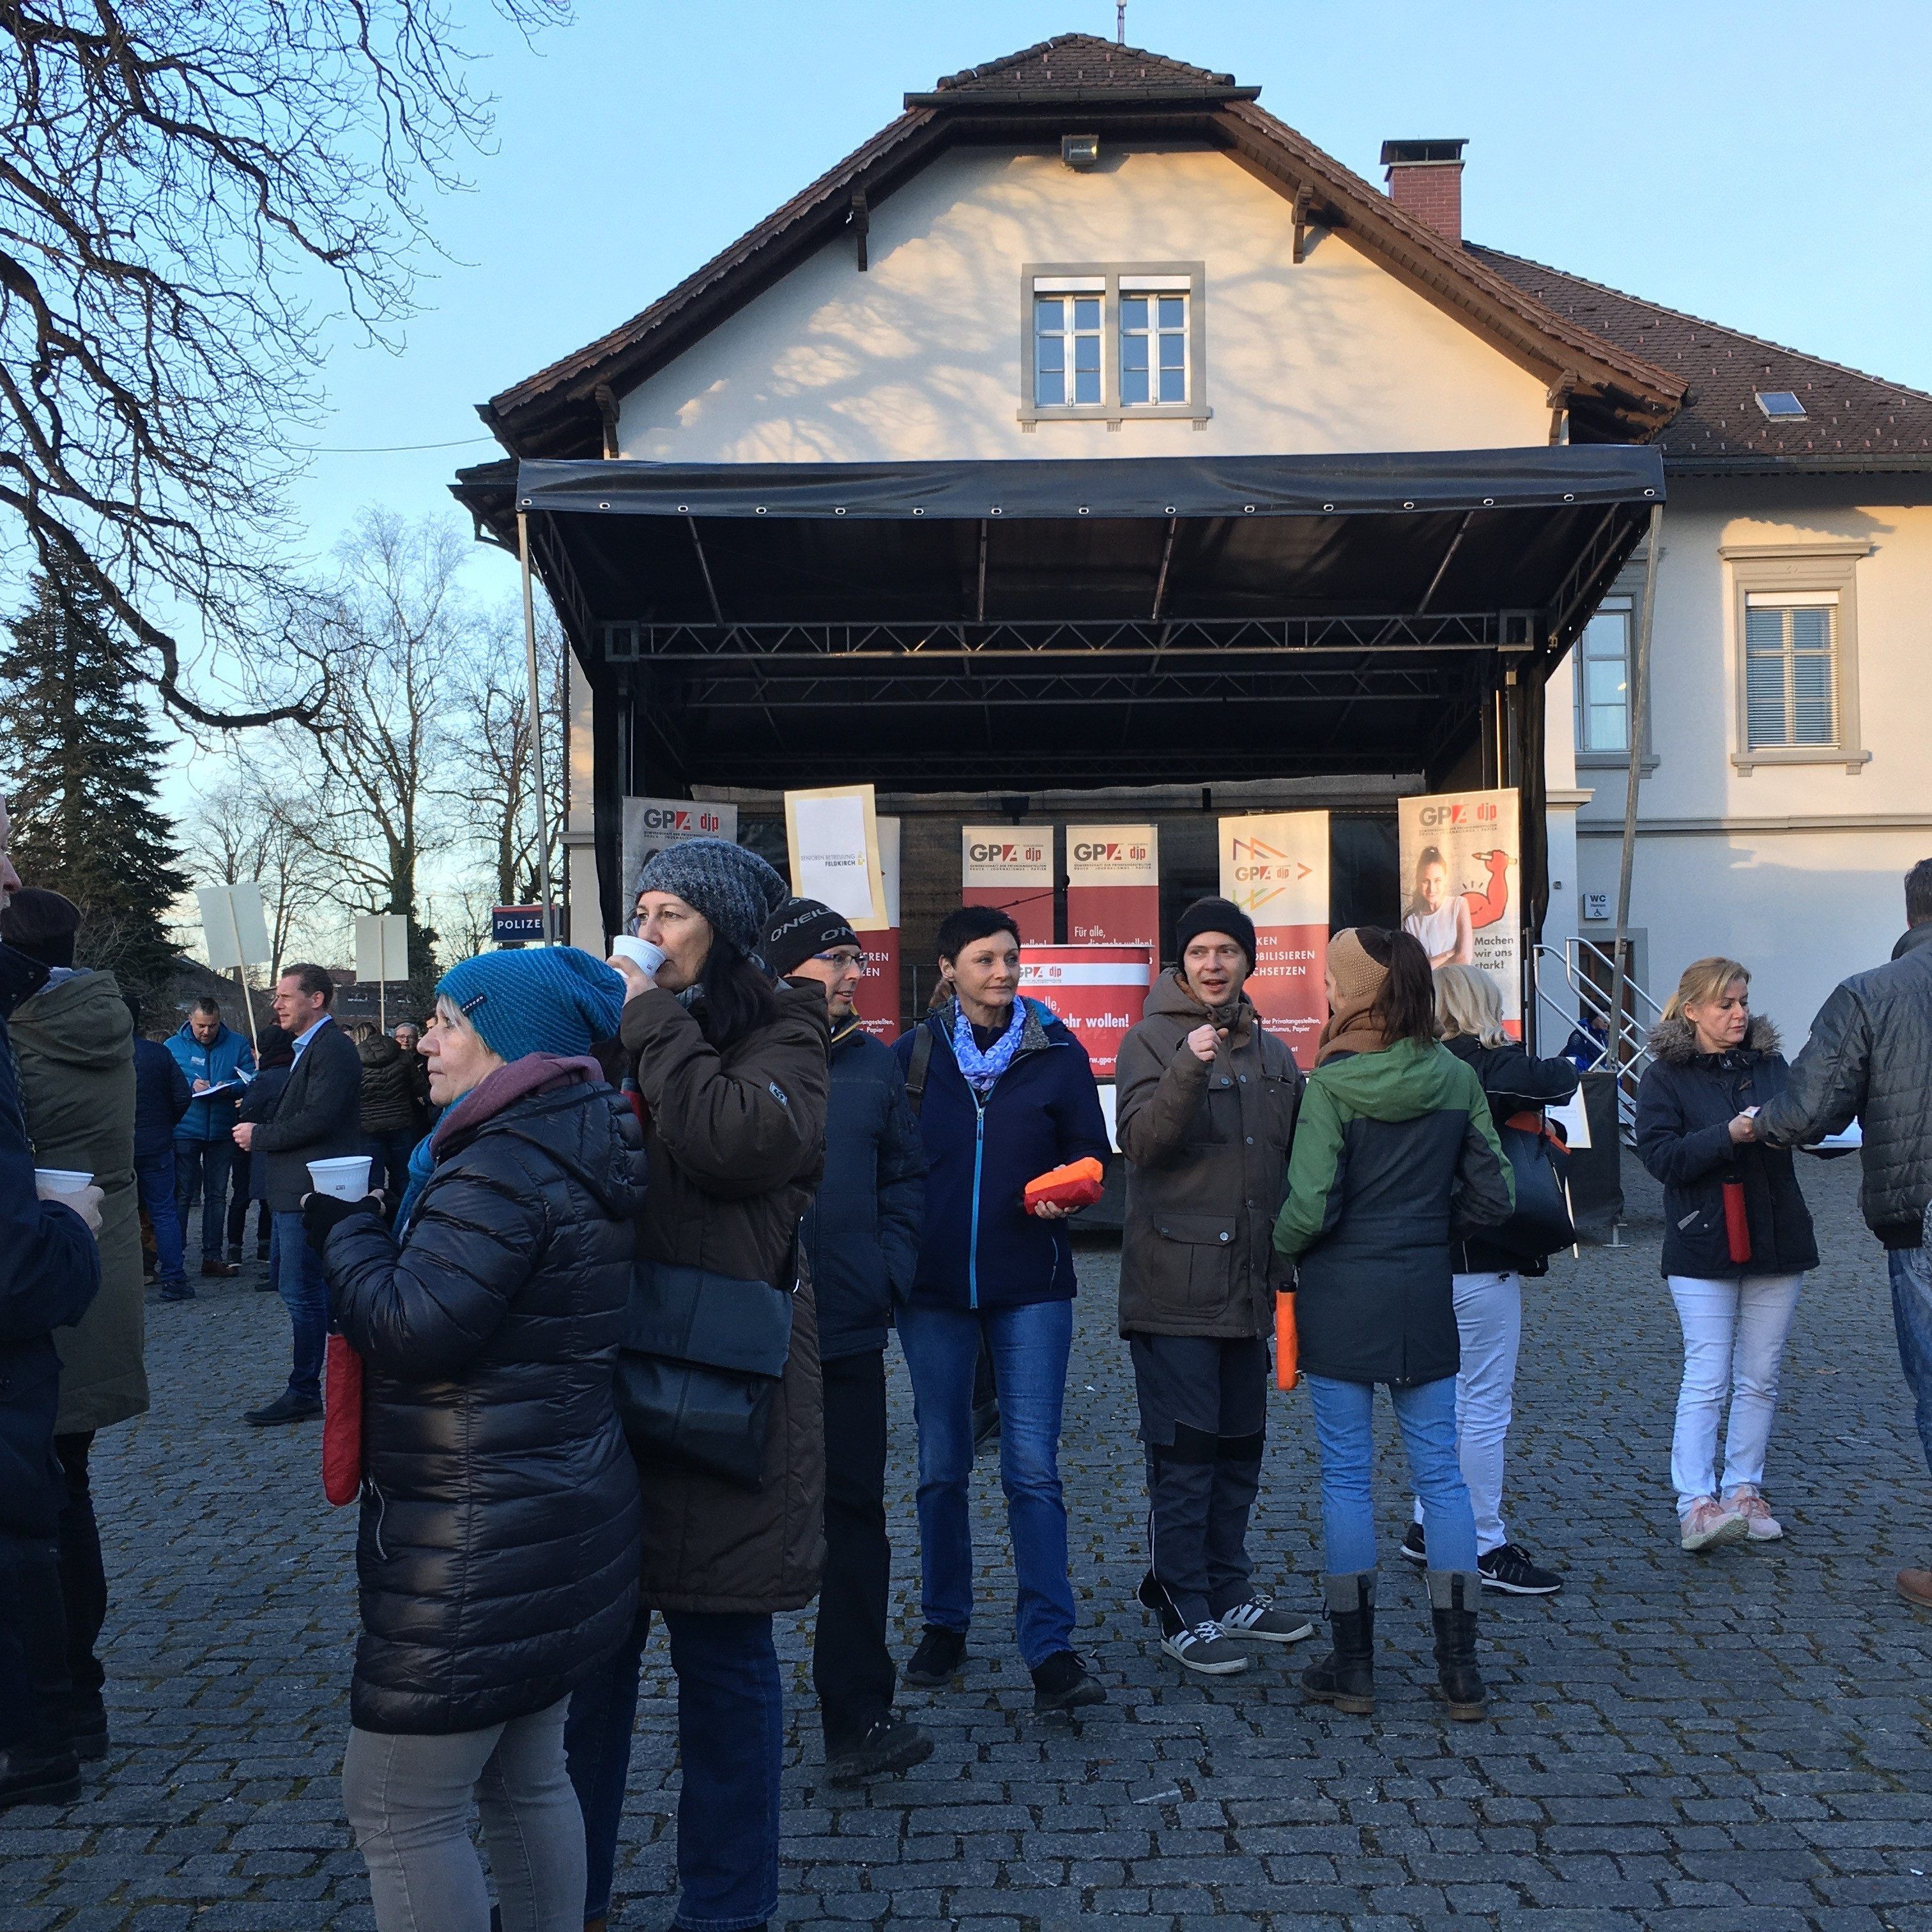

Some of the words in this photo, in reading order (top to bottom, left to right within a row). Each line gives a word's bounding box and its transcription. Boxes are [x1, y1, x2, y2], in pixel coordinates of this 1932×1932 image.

[1477, 803, 1497, 820] djp
[700, 813, 719, 831] djp
[1025, 848, 1041, 861] djp
[1130, 846, 1146, 860] djp
[1276, 867, 1289, 879] djp
[497, 919, 544, 930] POLIZE
[1075, 926, 1087, 937] Für
[1089, 926, 1106, 939] alle,
[1256, 936, 1278, 946] KEN
[1475, 935, 1514, 946] Machen
[1474, 949, 1492, 958] wir
[1049, 966, 1061, 977] djp
[1253, 965, 1307, 976] CHSETZEN
[1085, 1012, 1130, 1028] wollen!
[1292, 1025, 1310, 1034] Papier
